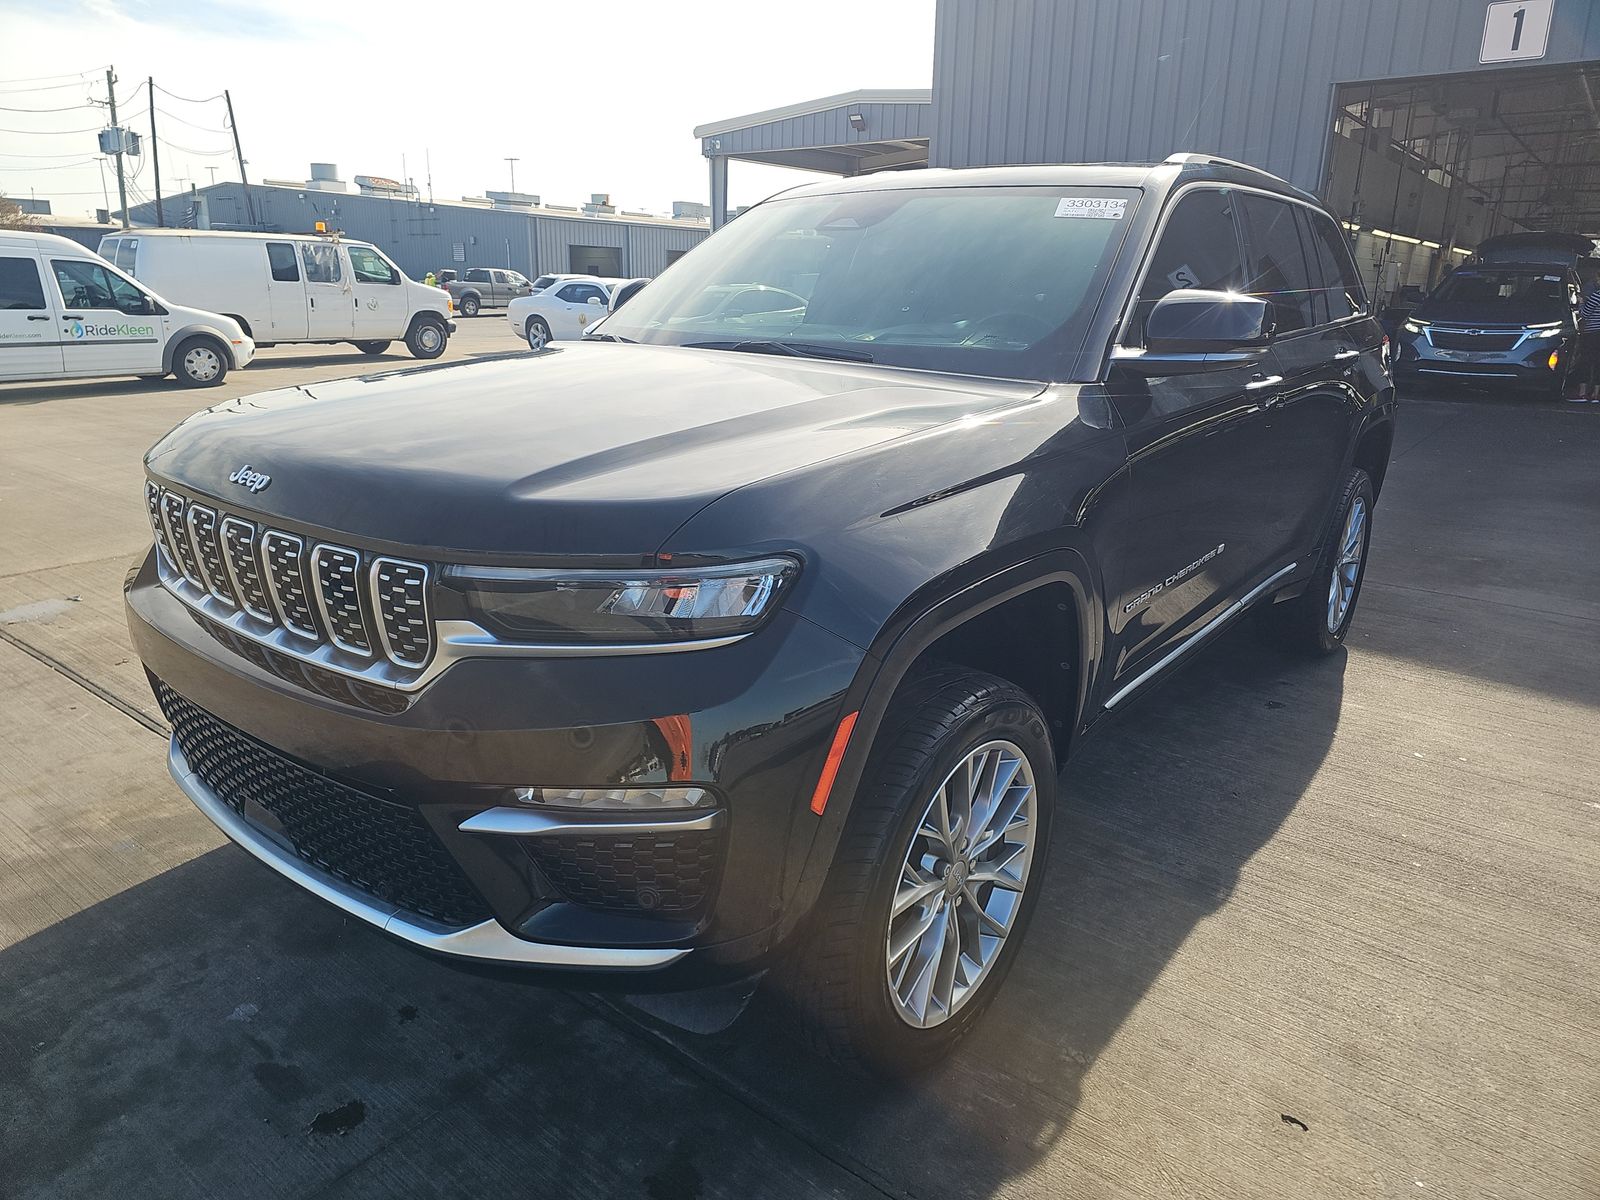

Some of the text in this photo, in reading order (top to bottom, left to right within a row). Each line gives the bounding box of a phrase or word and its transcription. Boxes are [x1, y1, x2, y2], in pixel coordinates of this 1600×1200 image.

[1511, 8, 1526, 51] 1
[1066, 199, 1127, 209] 3303134
[85, 324, 154, 337] RideKleen
[229, 464, 272, 494] Jeep
[1124, 548, 1217, 614] GRAND CHEROKEE
